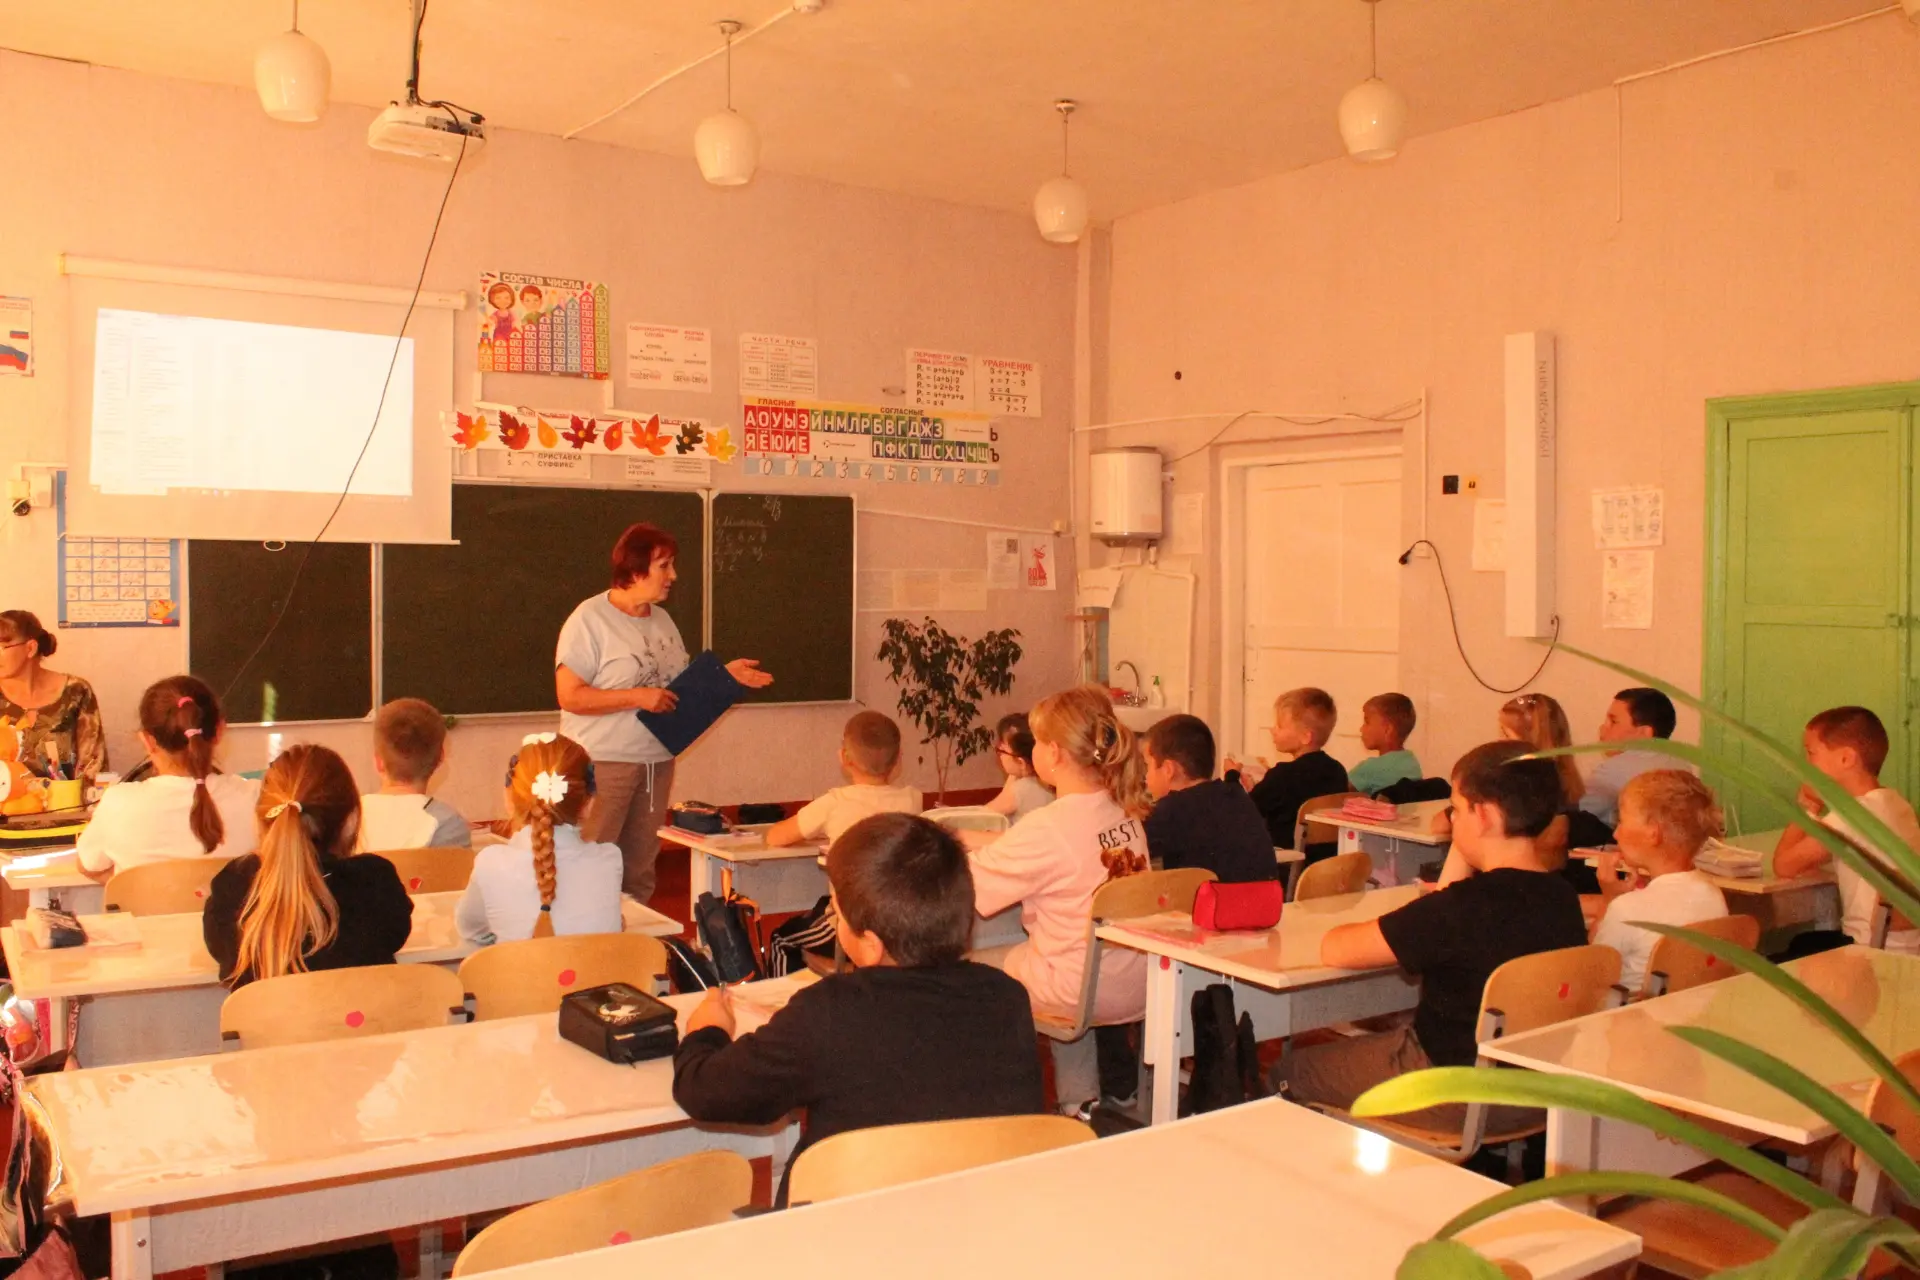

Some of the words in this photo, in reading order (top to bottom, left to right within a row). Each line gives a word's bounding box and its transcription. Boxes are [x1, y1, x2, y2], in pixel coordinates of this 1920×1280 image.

[502, 273, 545, 286] СОСТАВ
[546, 278, 583, 290] ЧИСЛА
[982, 359, 1033, 372] УРАВНЕНИЕ
[758, 398, 796, 407] ГЛАСНЫЕ
[880, 407, 925, 416] СОГЛАСНЫЕ
[538, 452, 582, 461] ПРИСТАВКА
[537, 460, 575, 468] СУФФИКС
[763, 459, 773, 475] 0
[813, 461, 824, 477] 2
[839, 463, 848, 479] 3
[865, 464, 872, 479] 4
[888, 464, 896, 480] 5
[910, 466, 919, 482] 6
[934, 467, 942, 483] 7
[957, 468, 966, 484] 8
[980, 469, 988, 484] 9
[1098, 819, 1139, 850] BEST
